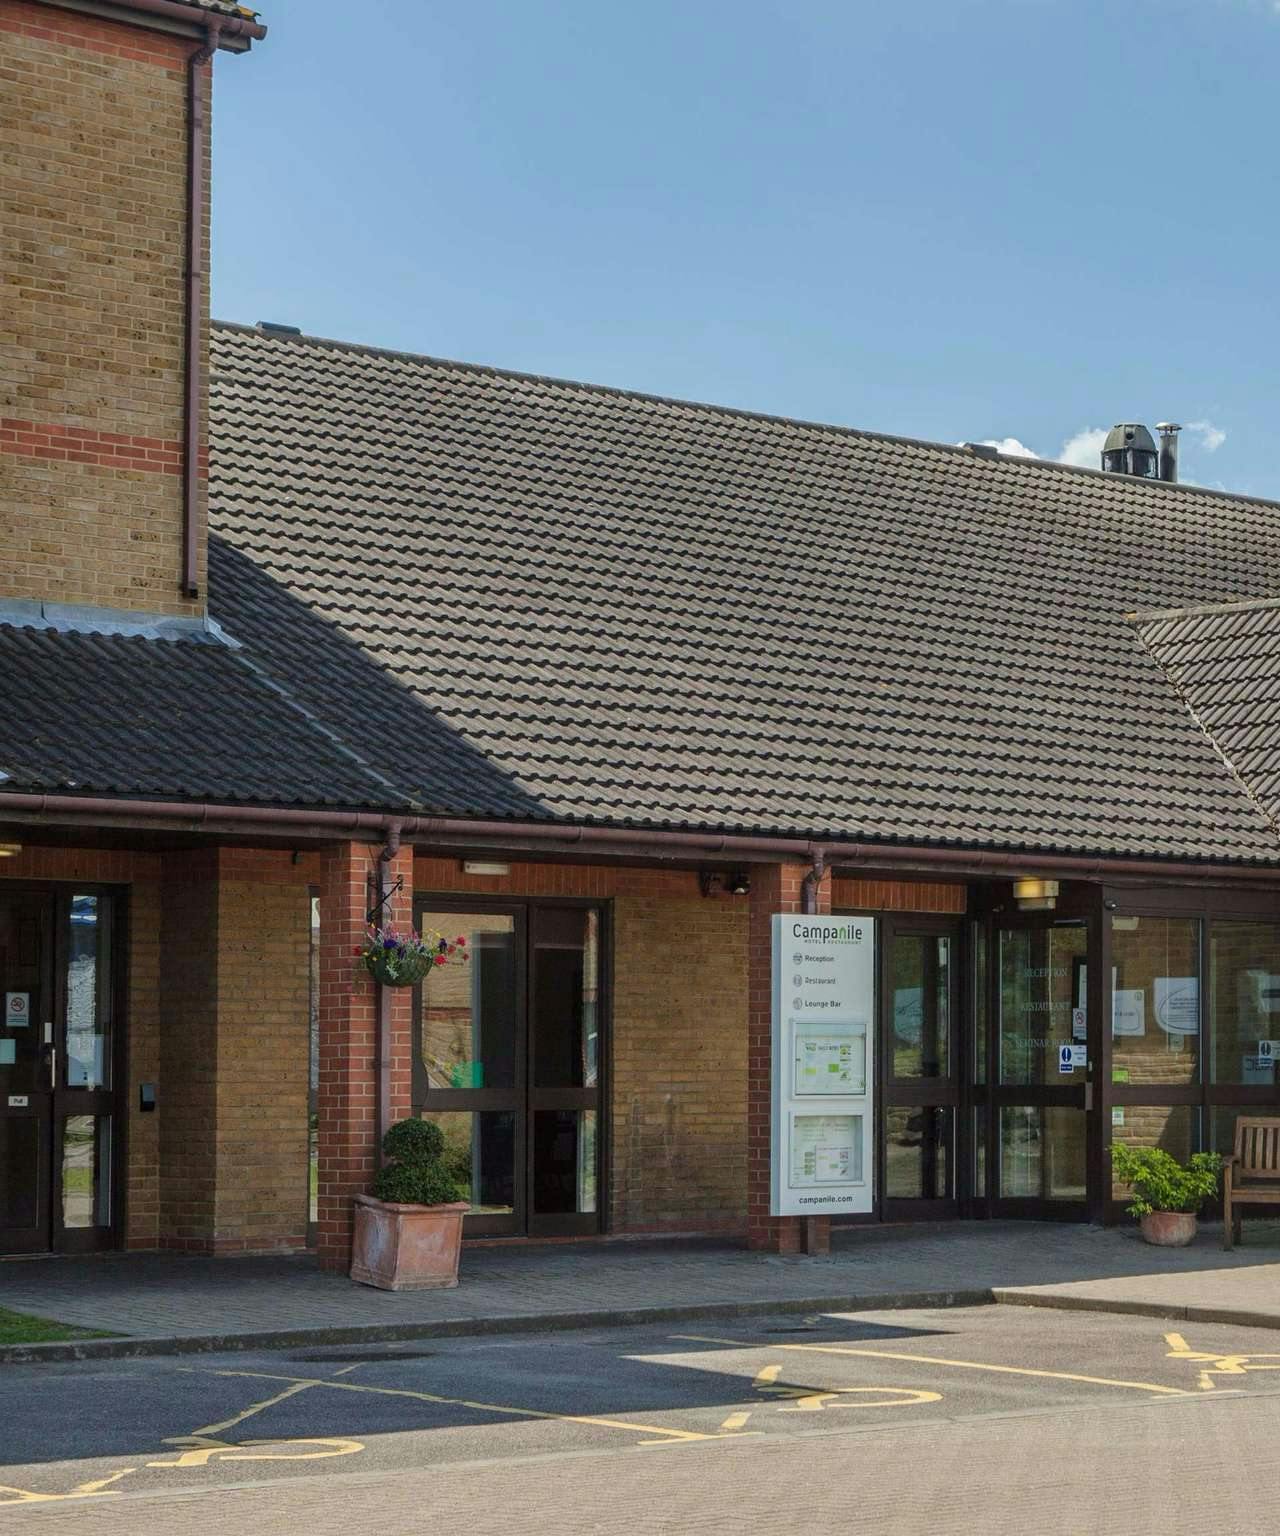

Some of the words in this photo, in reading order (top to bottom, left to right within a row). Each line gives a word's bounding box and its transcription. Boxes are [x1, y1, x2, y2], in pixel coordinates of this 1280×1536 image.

[793, 923, 862, 944] Campanile
[804, 955, 835, 963] Reception
[804, 977, 836, 985] Restaurant
[804, 1000, 828, 1009] Lounge
[830, 1000, 842, 1008] Bar
[798, 1194, 853, 1204] campanile.com
